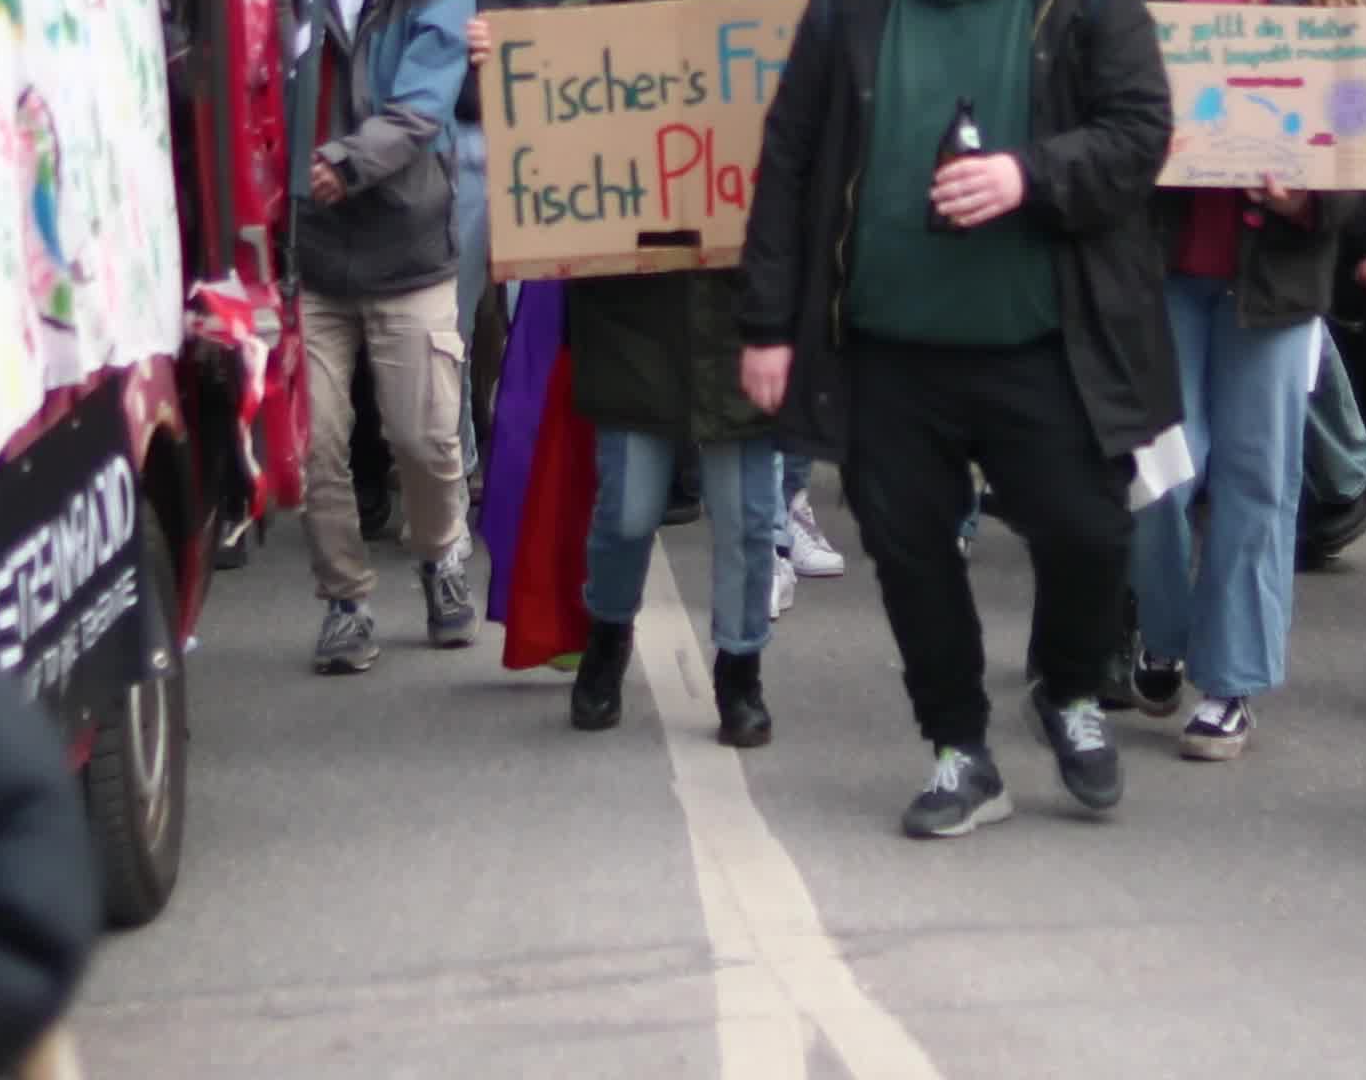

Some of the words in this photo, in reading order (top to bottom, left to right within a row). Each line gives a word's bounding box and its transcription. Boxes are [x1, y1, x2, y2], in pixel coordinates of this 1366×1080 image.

[499, 39, 708, 128] Fischer's
[508, 146, 649, 228] fischt
[655, 123, 761, 221] Pla
